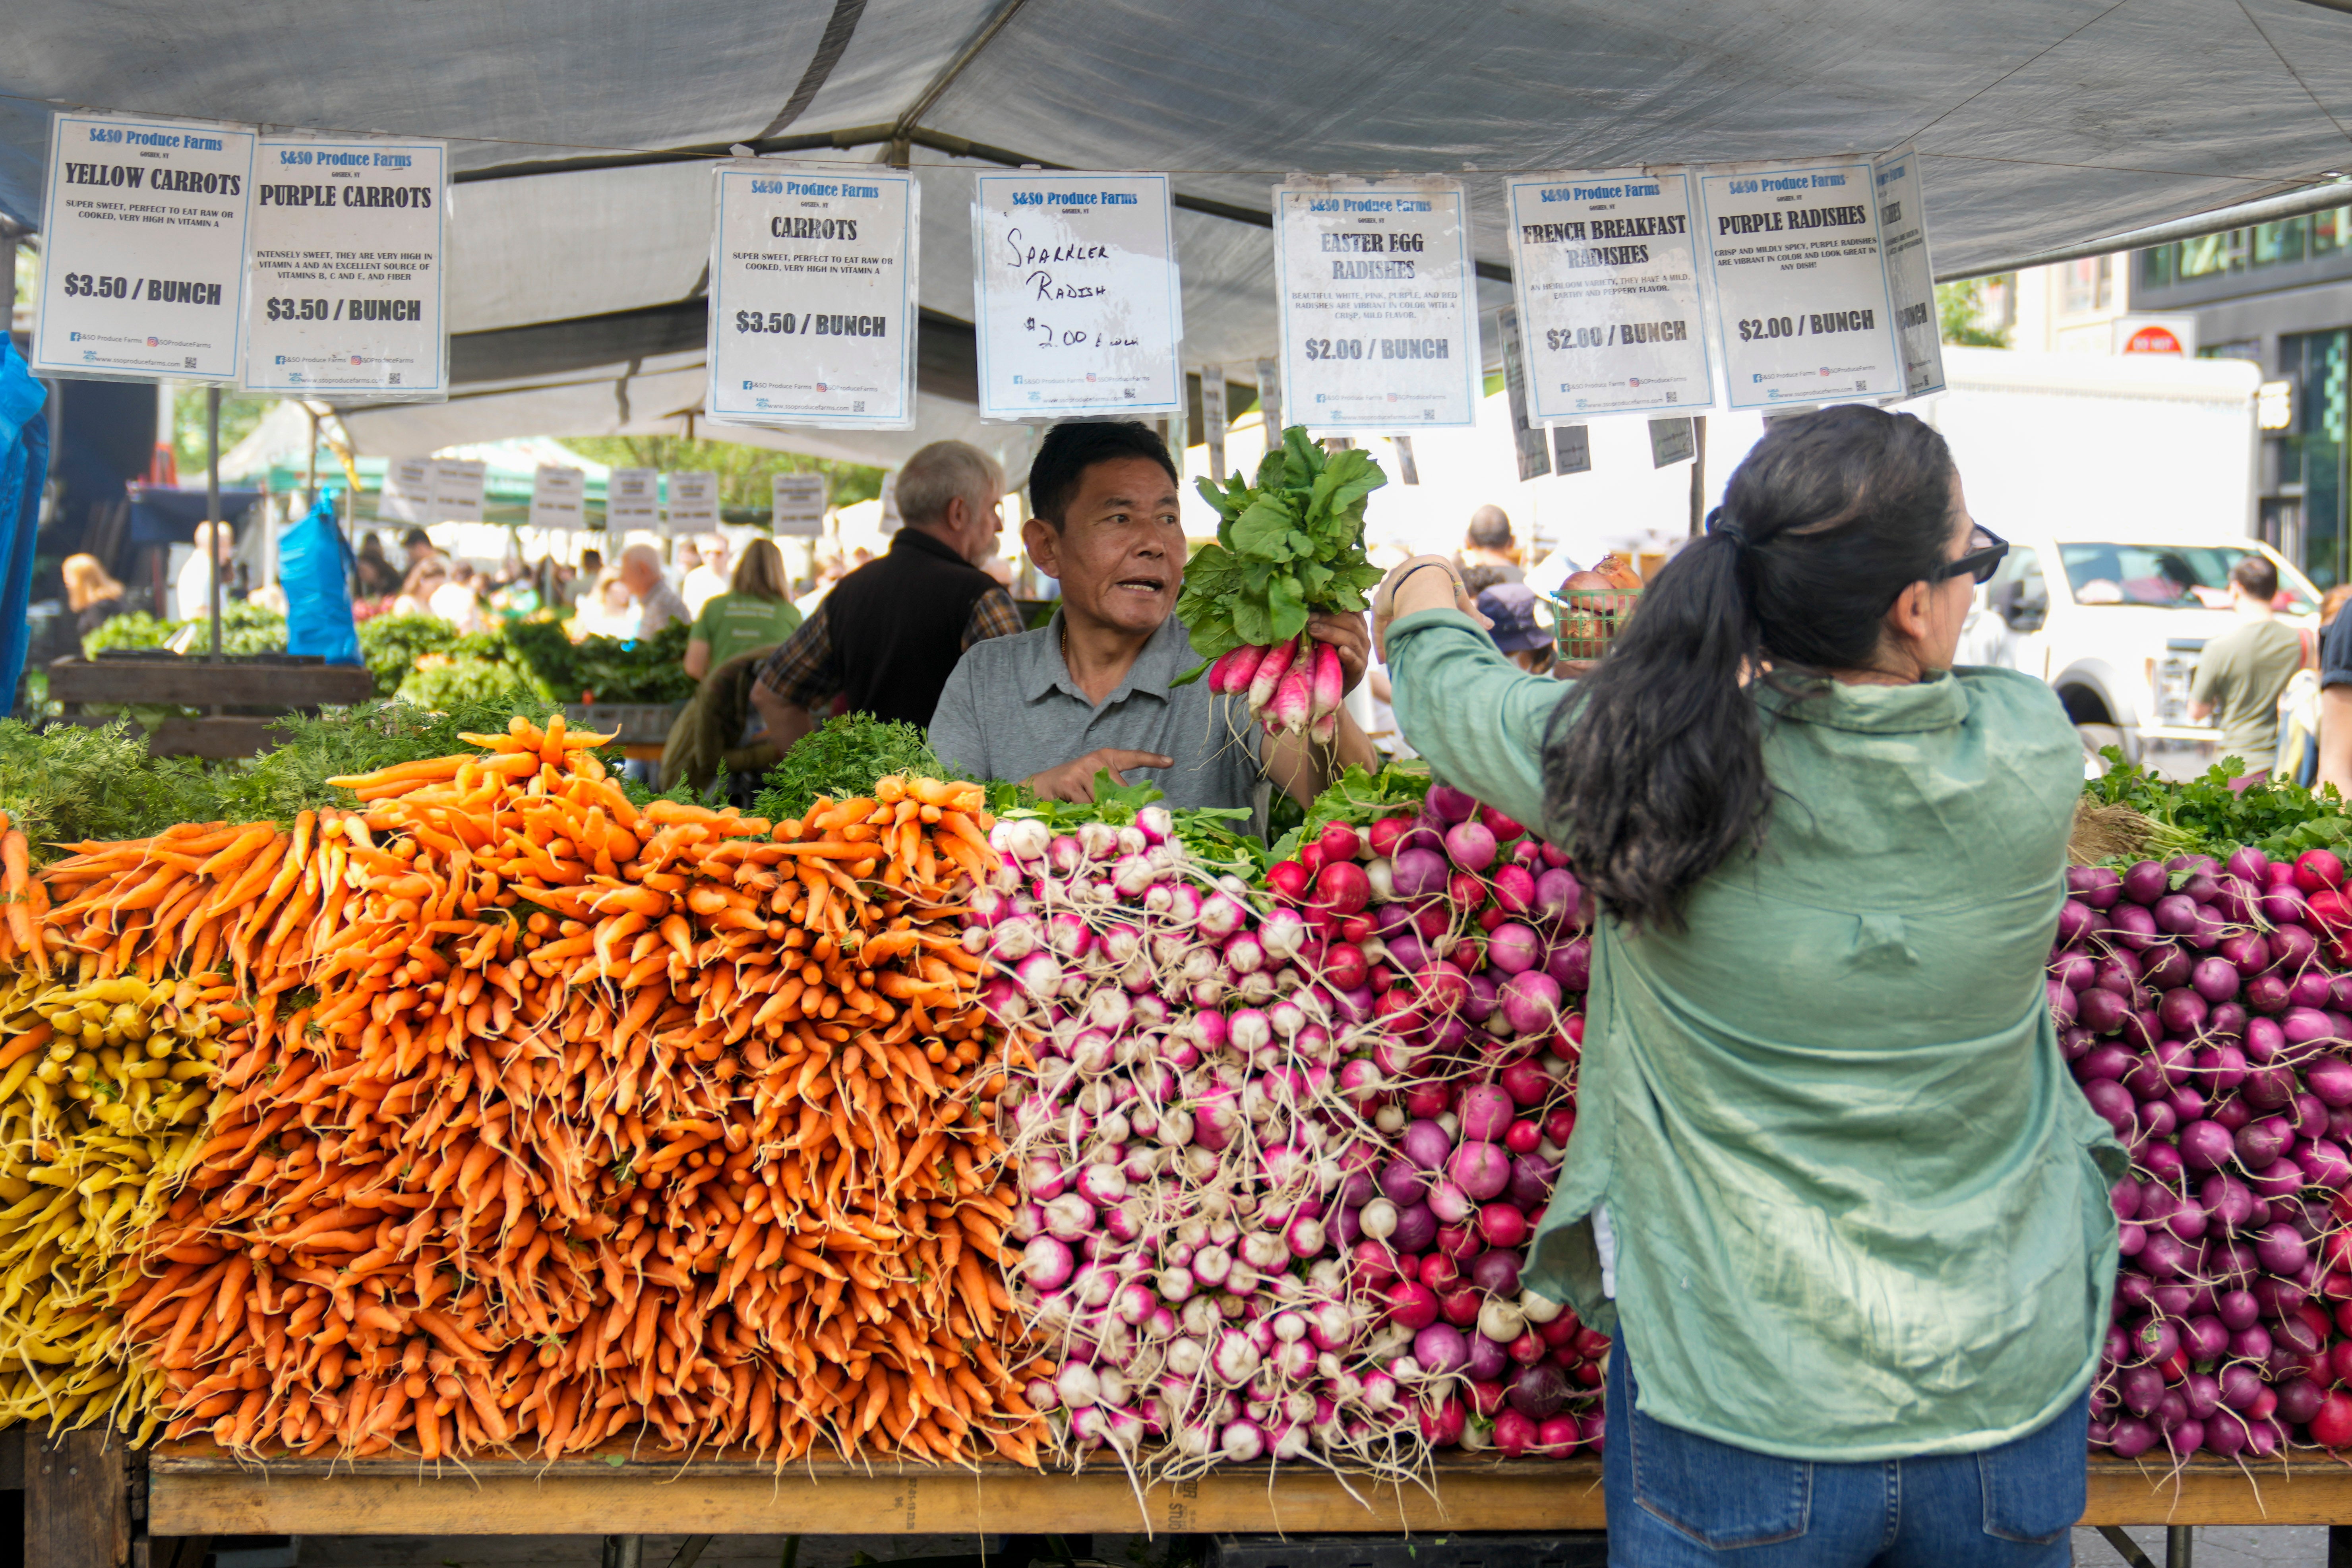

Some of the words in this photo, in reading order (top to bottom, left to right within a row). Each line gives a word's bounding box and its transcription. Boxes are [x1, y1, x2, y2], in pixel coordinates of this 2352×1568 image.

[90, 128, 122, 143] S&SO
[126, 131, 180, 147] Produce
[183, 135, 222, 151] Farms
[281, 151, 312, 165] S&SO
[317, 152, 369, 165] Produce
[373, 153, 411, 166] Farms
[65, 163, 145, 188] YELLOW
[150, 168, 240, 196] CARROTS
[752, 180, 782, 194] S&SO
[787, 182, 838, 196] Produce
[842, 184, 878, 198] Farms
[1729, 180, 1758, 194] S&SO
[1761, 177, 1808, 192] Produce
[1811, 174, 1845, 187] Farms
[259, 184, 336, 206] PURPLE
[343, 186, 431, 208] CARROTS
[1012, 192, 1043, 205] S&SO
[1047, 192, 1097, 204] Produce
[1101, 192, 1137, 204] Farms
[1541, 188, 1570, 202] S&SO
[1573, 186, 1622, 200] Produce
[1624, 184, 1660, 197] Farms
[96, 201, 126, 211] SWEET,
[129, 204, 166, 213] PERFECT
[1310, 199, 1339, 211] S&SO
[1343, 199, 1392, 211] Produce
[1396, 199, 1432, 211] Farms
[78, 211, 116, 220] COOKED,
[178, 218, 211, 226] VITAMIN
[771, 216, 857, 240] CARROTS
[1718, 212, 1783, 235] PURPLE
[1787, 205, 1866, 229] RADISHES
[1522, 221, 1586, 244] FRENCH
[1590, 215, 1686, 239] BREAKFAST
[1322, 233, 1383, 252] EASTER
[1388, 233, 1423, 252] EGG
[1810, 240, 1839, 248] PURPLE
[1841, 237, 1877, 246] RADISHES
[762, 253, 790, 261] SWEET,
[1566, 244, 1649, 268] RADISHES
[1733, 256, 1765, 264] VIBRANT
[1332, 259, 1415, 279] RADISHES
[64, 273, 127, 298] $3.50
[147, 279, 221, 305] BUNCH
[267, 297, 328, 321] $3.50
[348, 299, 420, 321] BUNCH
[736, 310, 796, 334] $3.50
[815, 314, 885, 337] BUNCH
[1738, 316, 1793, 342] $2.00
[1810, 309, 1874, 334] BUNCH
[1547, 327, 1602, 351] $2.00
[1620, 320, 1686, 345] BUNCH
[1305, 338, 1362, 361] $2.00
[1381, 339, 1448, 359] BUNCH
